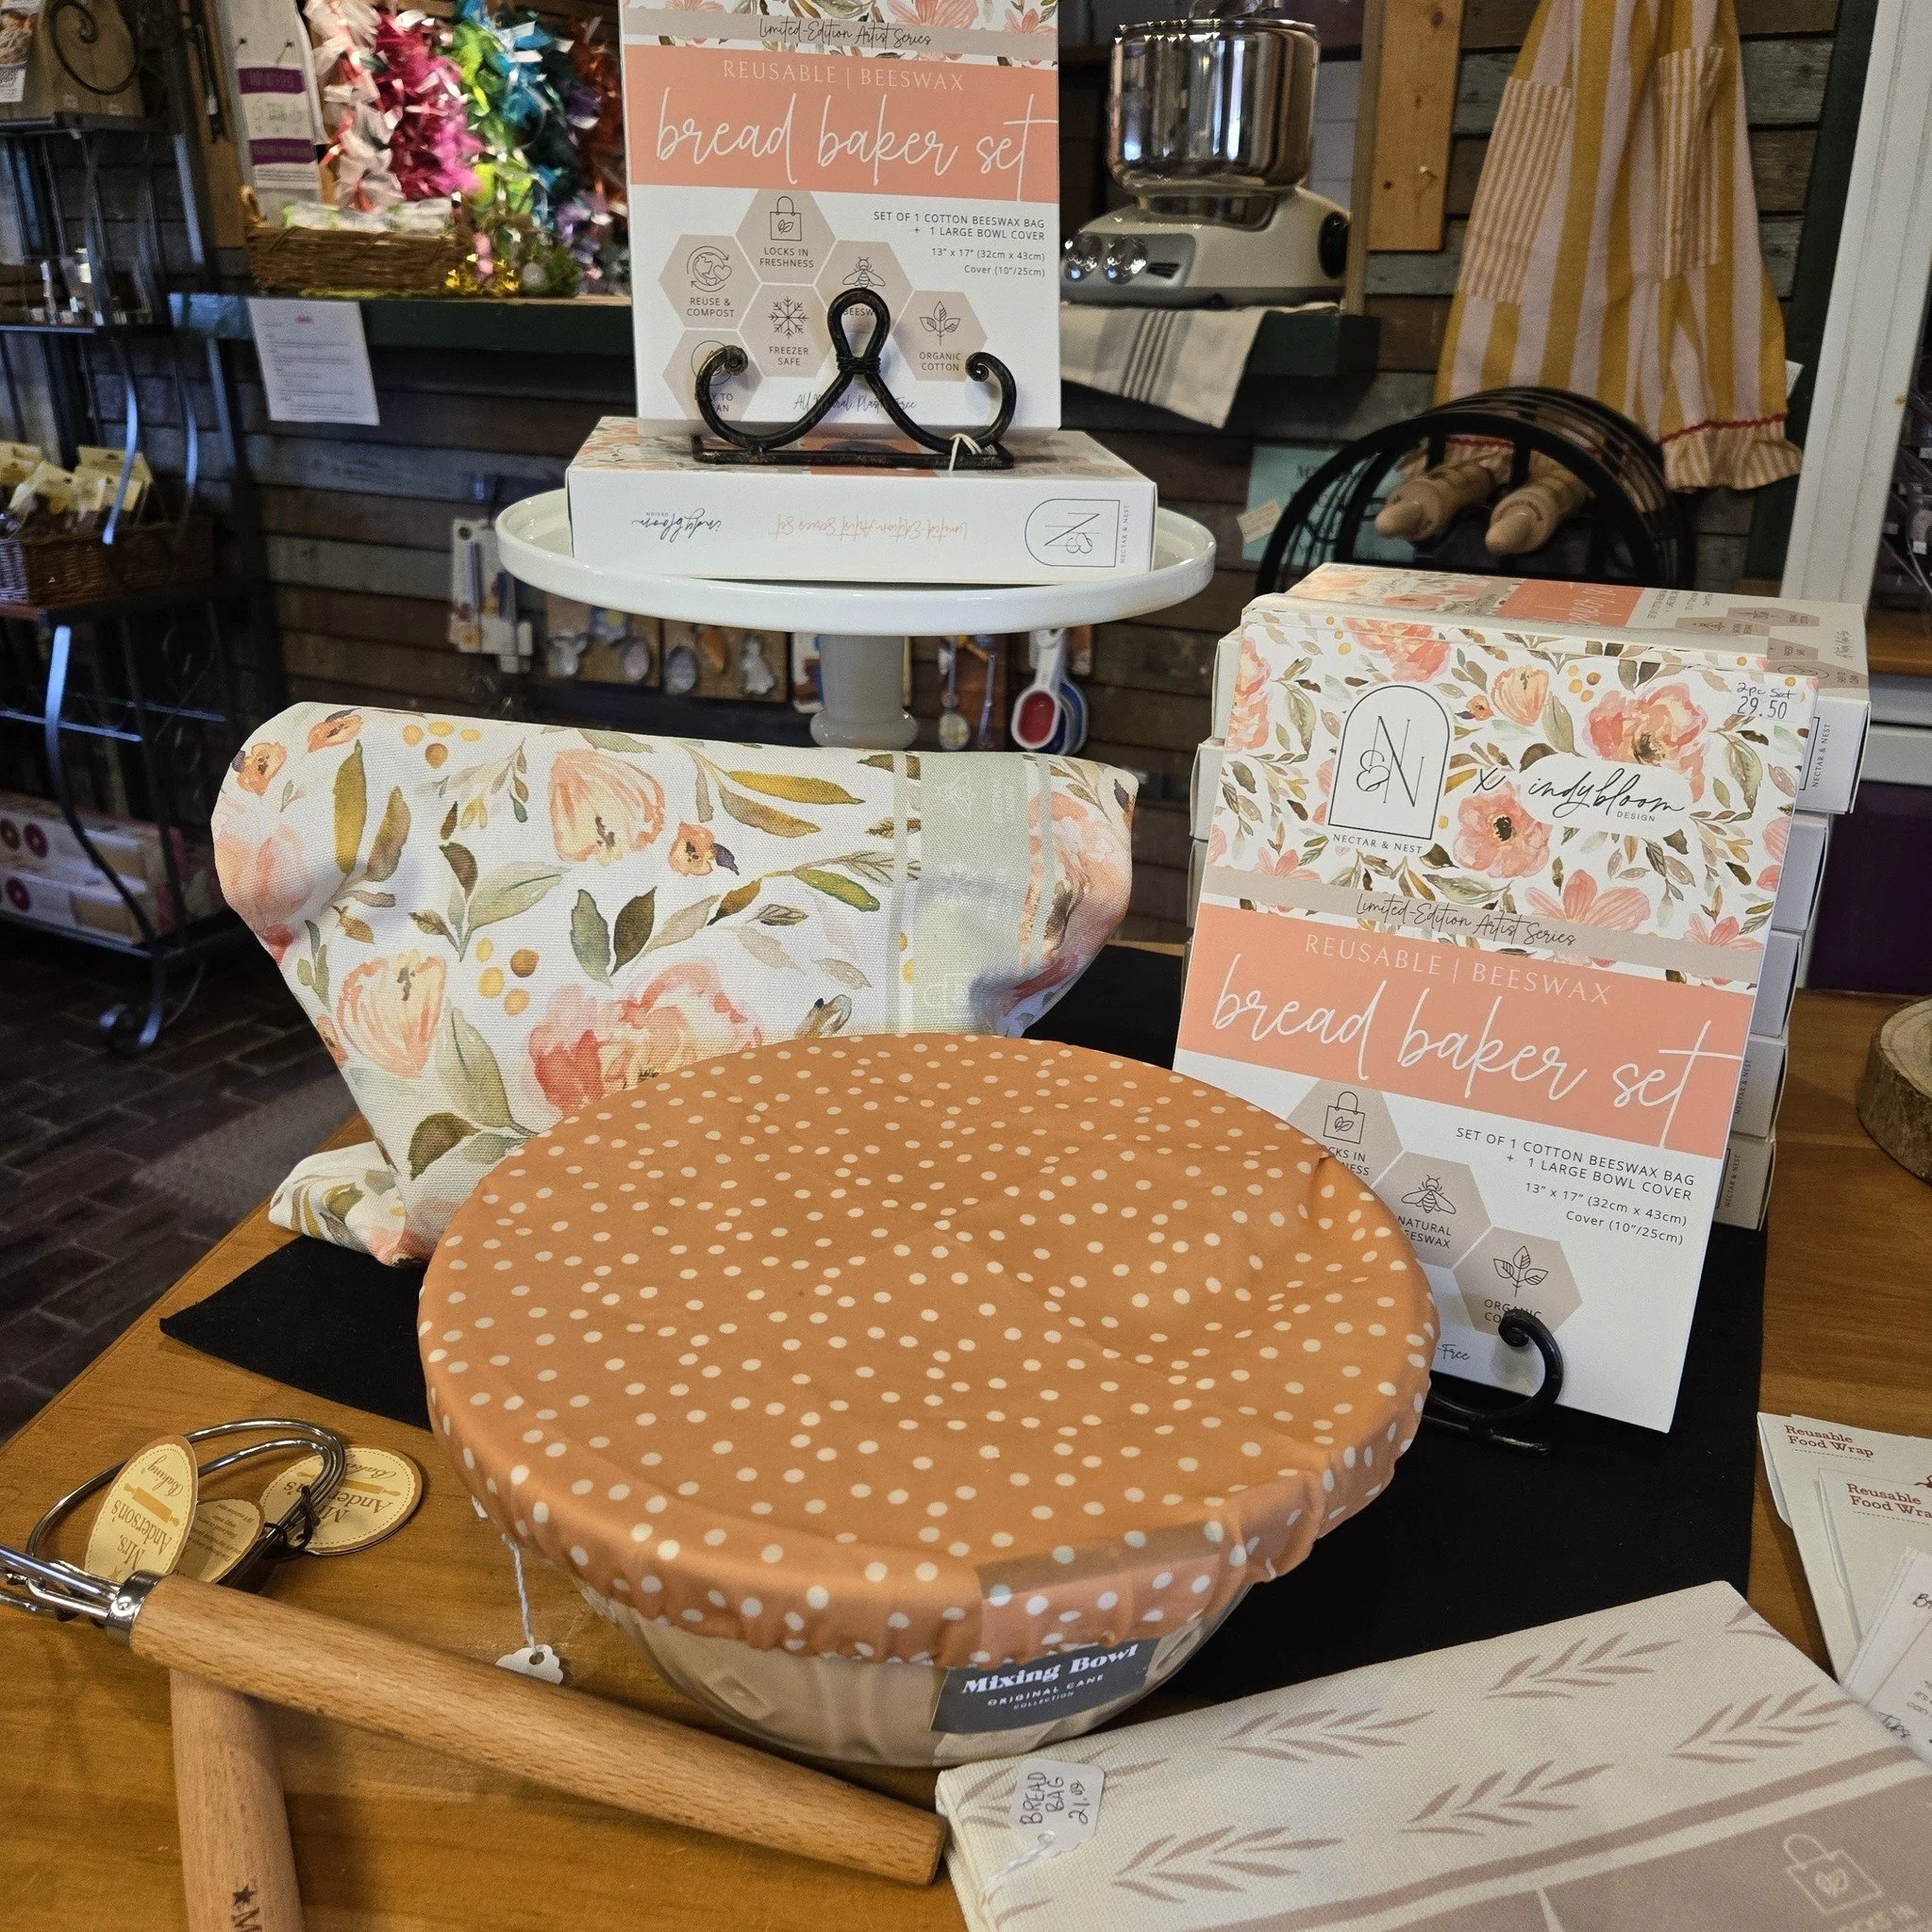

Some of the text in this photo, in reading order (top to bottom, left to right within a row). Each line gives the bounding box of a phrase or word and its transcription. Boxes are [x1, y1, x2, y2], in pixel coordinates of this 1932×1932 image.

[759, 16, 931, 49] Limited-Edition Artist Series
[724, 59, 838, 84] REUSABLE
[860, 67, 964, 92] BEESWAX
[657, 87, 1058, 202] bread baker set
[874, 211, 1045, 228] SET OF 1 COTTON BEESWAX BAG
[930, 226, 935, 236] 1
[940, 227, 974, 238] LARGE
[976, 229, 1008, 240] BOWL
[1010, 230, 1045, 241] COVER
[763, 246, 809, 257] LOCKS IN
[976, 249, 1006, 259] (32cm
[1016, 252, 1045, 262] 43cm)
[759, 258, 814, 269] FRESHNESS
[964, 265, 991, 275] Cover
[687, 308, 735, 318] COMPOST
[690, 297, 731, 307] REUSE &
[768, 345, 809, 356] FREEZER
[777, 357, 801, 366] SAFE
[919, 351, 962, 361] ORGANIC
[921, 362, 959, 372] COTTON
[1120, 534, 1128, 563] NECTAR
[1737, 682, 1766, 696] 2pc
[1738, 695, 1788, 720] 29.50
[1811, 756, 1824, 788] NECTAR
[1821, 724, 1831, 744] NEST
[1616, 810, 1657, 823] DESIGN
[1333, 834, 1423, 854] NECTAR & NEST
[1357, 891, 1577, 946] Limited-Edition Artist Series
[1305, 933, 1442, 975] REUSABLE
[1472, 962, 1611, 1006] BEESWAX
[1211, 953, 1743, 1148] bread baker set
[1735, 1086, 1747, 1115] NECTAR
[1353, 1152, 1366, 1162] IN
[1456, 1127, 1695, 1186] SET OF 1 COTTON BEESWAX BAG
[1528, 1158, 1535, 1168] 1
[1541, 1159, 1588, 1180] LARGE
[1591, 1171, 1636, 1190] BOWL
[1641, 1181, 1692, 1202] COVER
[1724, 1182, 1736, 1208] NECTAR
[1733, 1154, 1741, 1172] NEST
[1566, 1210, 1605, 1227] Cover
[1587, 1194, 1628, 1213] (32cm
[1645, 1208, 1689, 1227] 43cm)
[1397, 1215, 1451, 1236] NATURAL
[1784, 1424, 1853, 1443] Reusable
[1788, 1435, 1874, 1458] Food Wrap
[1846, 1482, 1922, 1505] Reusable
[1850, 1495, 1932, 1519] Food Wra
[111, 1500, 173, 1556] Anderson's
[118, 1535, 145, 1571] Mrs.
[962, 1643, 1138, 1694] Mixing Bowl
[988, 1674, 1104, 1707] ORIGINAL CANE
[1013, 1690, 1074, 1709] COLLECTION
[1020, 1772, 1046, 1824] BREAD
[1045, 1776, 1064, 1812] BAG
